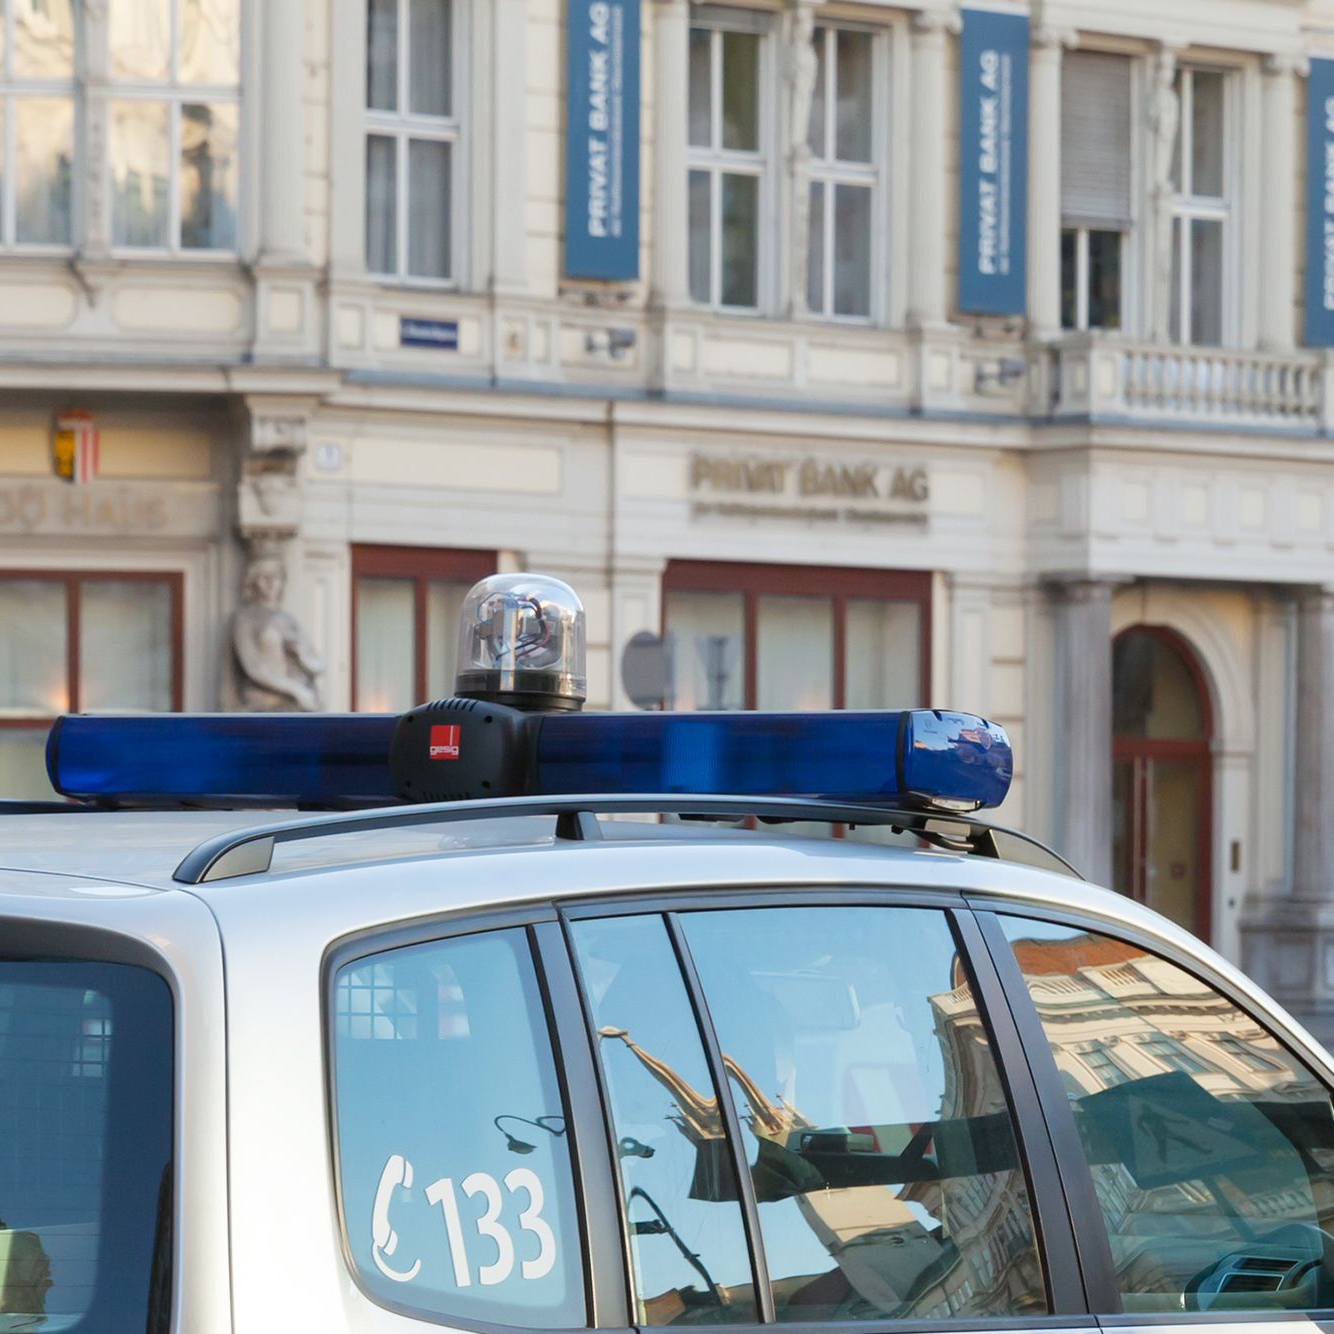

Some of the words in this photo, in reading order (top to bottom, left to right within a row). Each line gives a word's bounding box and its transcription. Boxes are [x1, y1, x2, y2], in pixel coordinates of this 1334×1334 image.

[589, 2, 610, 45] AG
[588, 50, 609, 131] BANK
[980, 49, 999, 90] AG
[979, 96, 998, 173] BANK
[588, 134, 608, 237] PRIVAT
[979, 178, 997, 275] PRIVAT
[690, 453, 791, 494] PRIVAT
[799, 457, 879, 500] BANK
[889, 465, 929, 501] AG
[426, 1167, 556, 1287] 133
